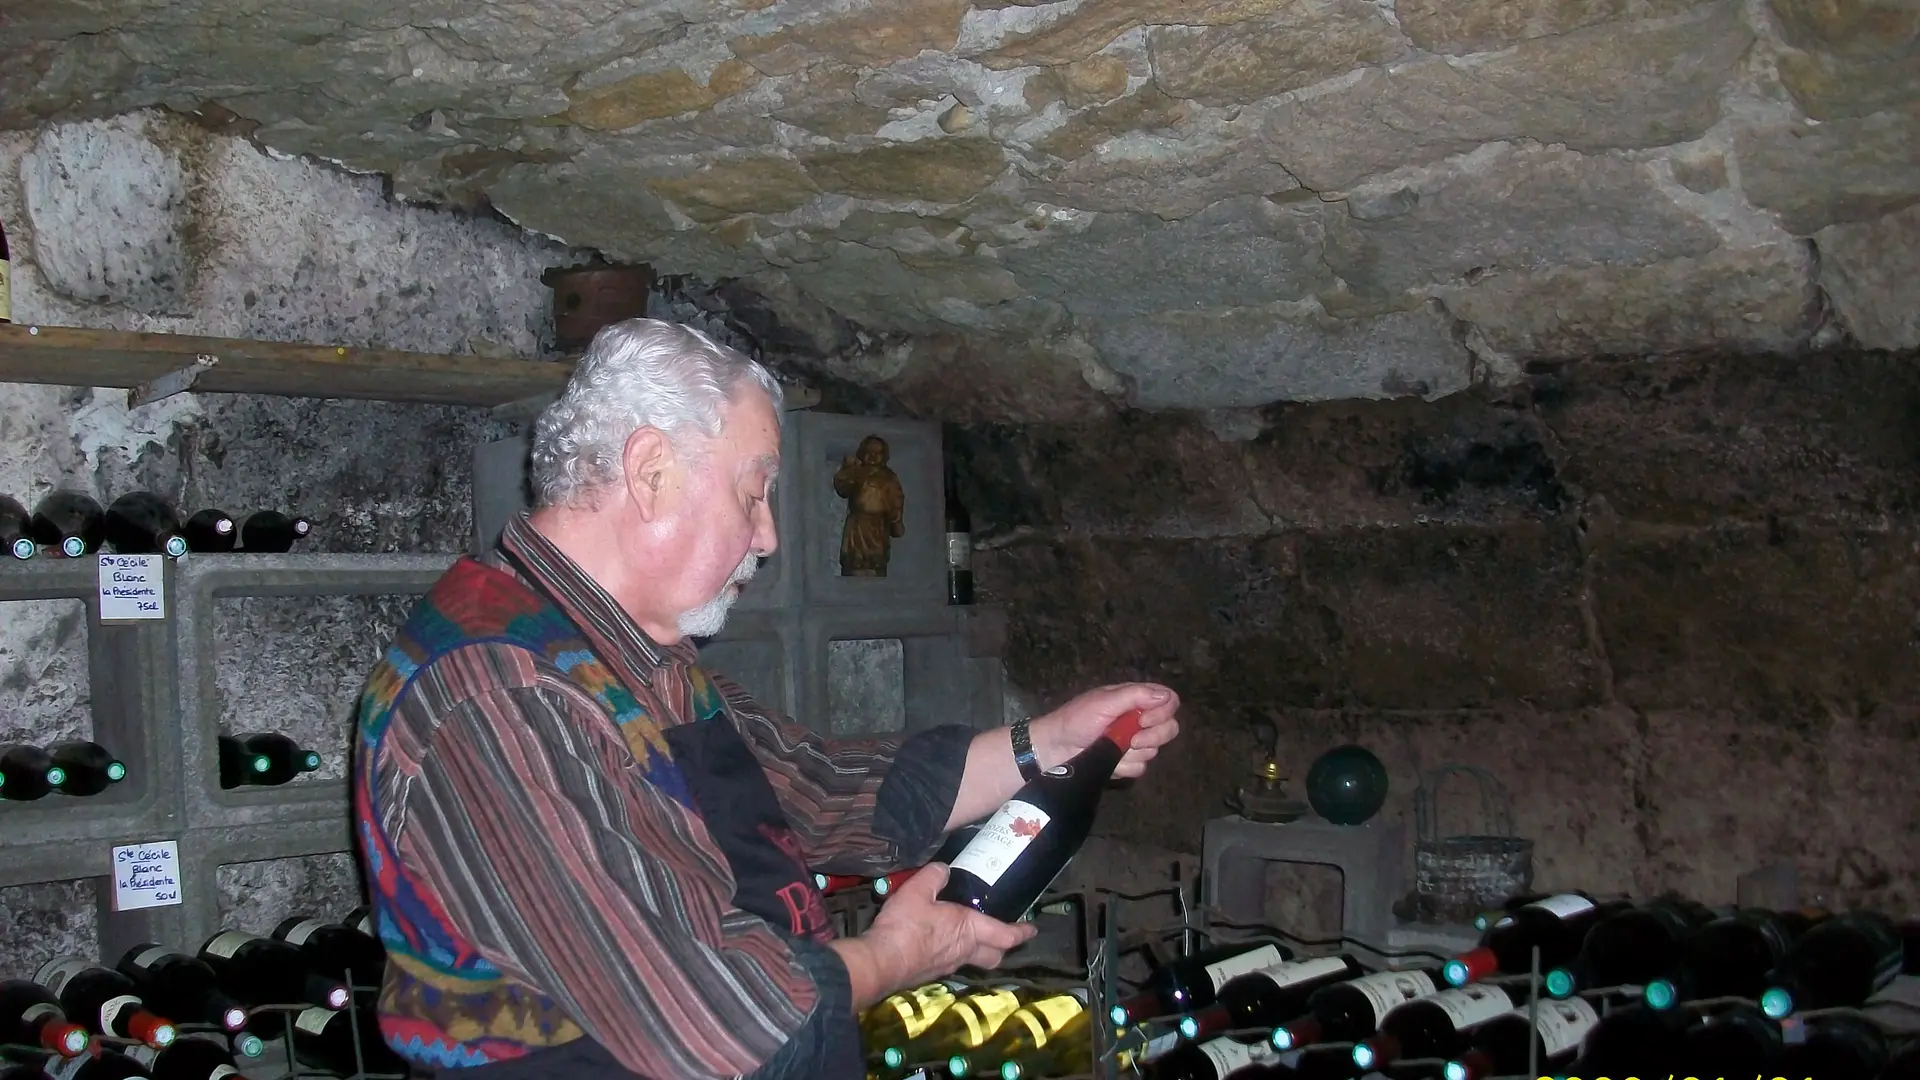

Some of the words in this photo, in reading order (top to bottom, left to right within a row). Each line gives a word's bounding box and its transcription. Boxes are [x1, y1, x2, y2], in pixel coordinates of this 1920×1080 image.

[117, 557, 149, 568] Cécile
[113, 572, 147, 583] Blanc
[112, 585, 156, 597] Présidente
[137, 601, 159, 611] 75cl
[138, 848, 172, 861] Cécile
[132, 864, 163, 874] Blanc
[129, 876, 175, 888] Présidente
